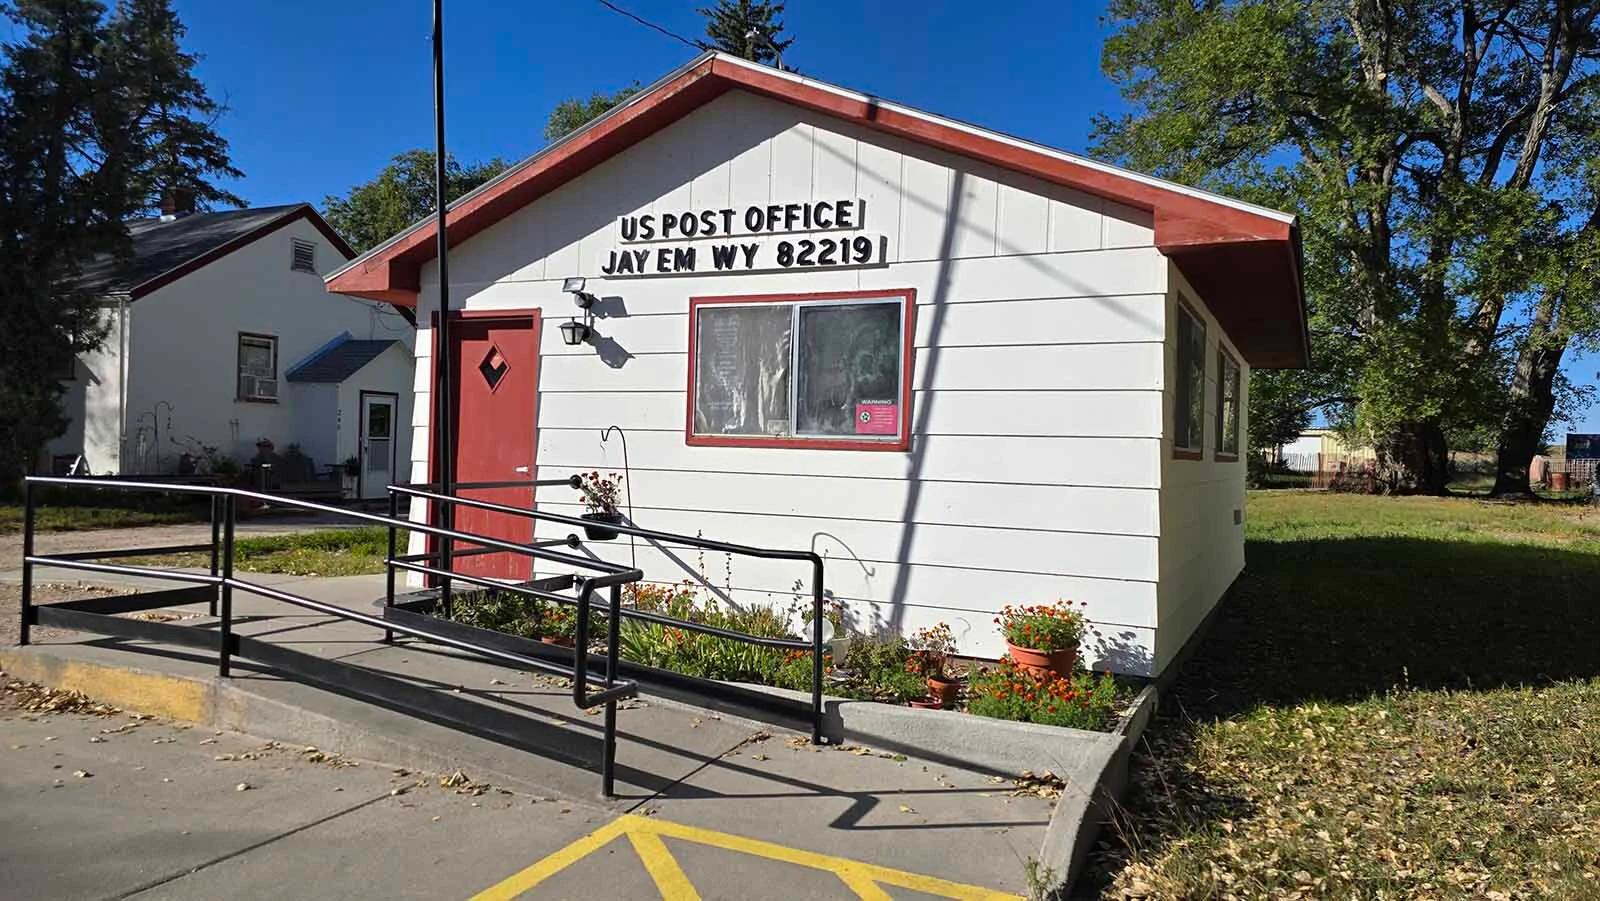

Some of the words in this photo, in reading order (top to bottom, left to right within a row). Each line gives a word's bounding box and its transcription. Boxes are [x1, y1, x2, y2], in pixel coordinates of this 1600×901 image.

[621, 214, 656, 241] US
[662, 208, 737, 238] POST
[745, 200, 854, 233] OFFICE
[601, 249, 650, 275] JAY
[657, 246, 697, 273] EM
[711, 242, 760, 270] WY
[776, 235, 873, 268] 82219
